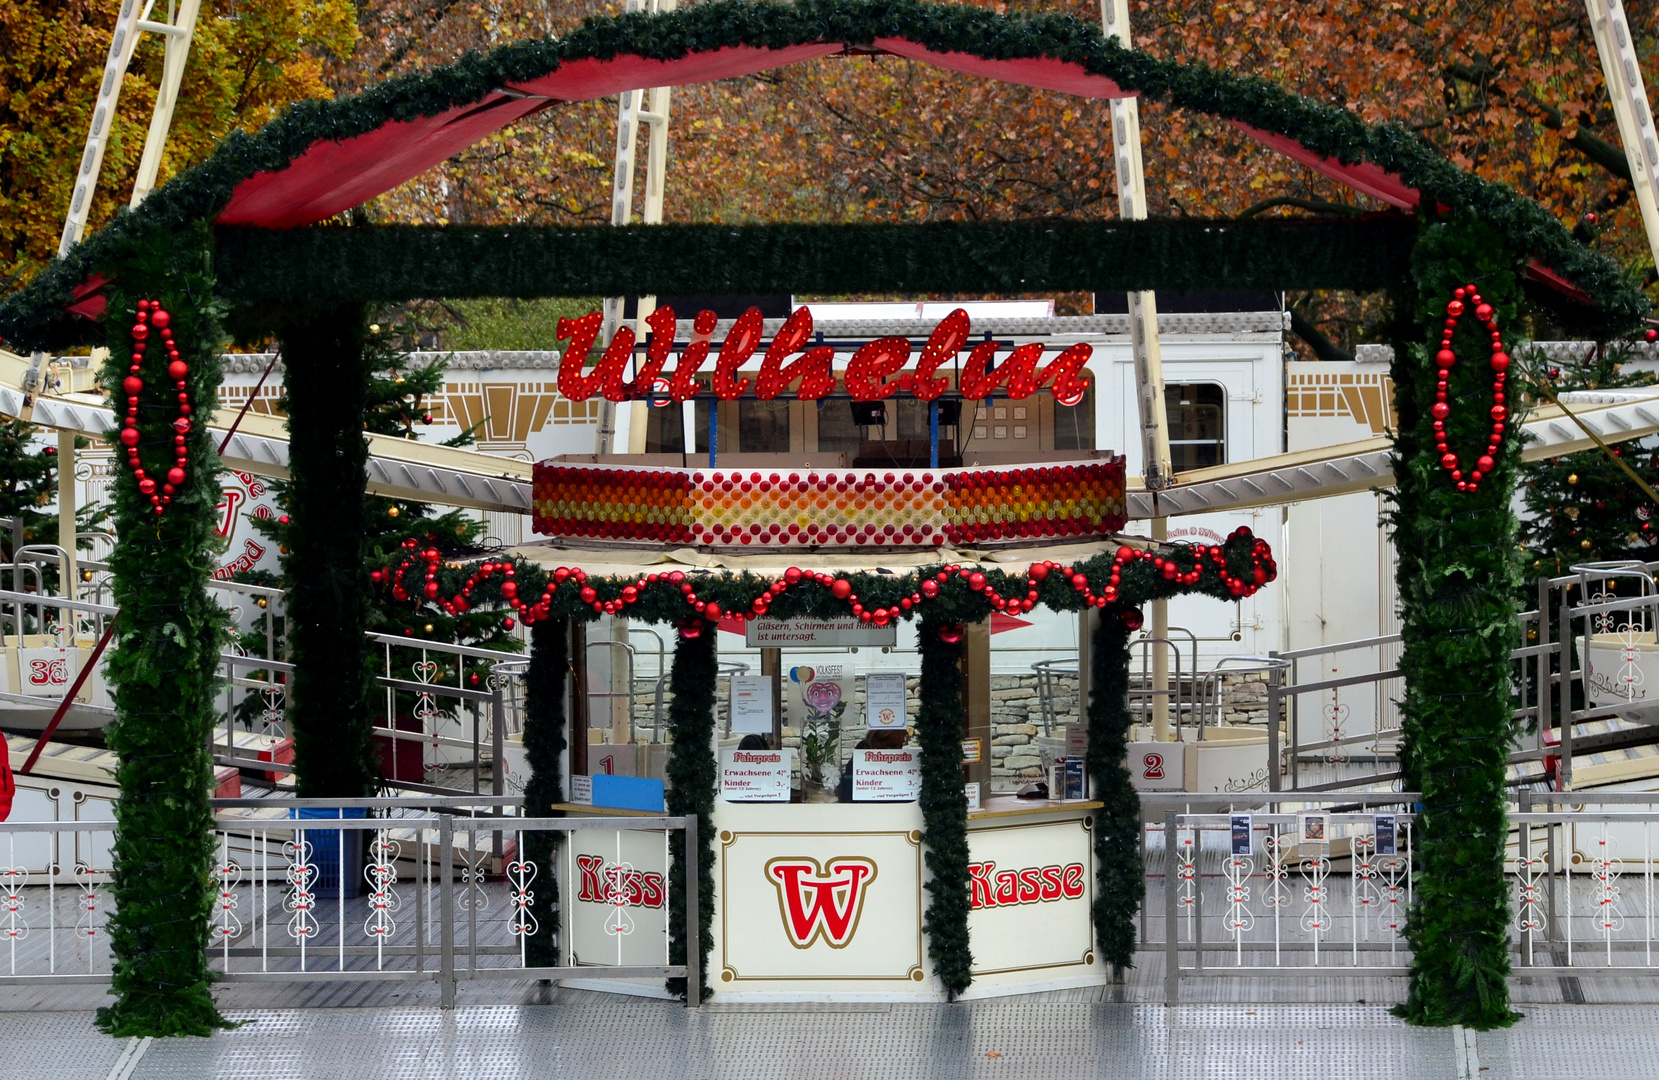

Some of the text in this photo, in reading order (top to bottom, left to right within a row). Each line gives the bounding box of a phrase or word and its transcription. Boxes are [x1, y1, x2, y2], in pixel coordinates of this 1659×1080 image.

[557, 305, 1093, 402] Wilhelm
[757, 621, 791, 631] Gläsern,
[794, 621, 834, 630] Schirmen
[837, 622, 854, 630] und
[757, 632, 816, 641] ist untersagt.
[599, 755, 614, 775] 1
[733, 752, 781, 764] Fahrpreis
[864, 751, 912, 764] Fahrpreis
[1143, 753, 1165, 779] 2
[576, 854, 667, 909] Kass
[967, 861, 1085, 911] Kasse
[764, 856, 878, 949] W
